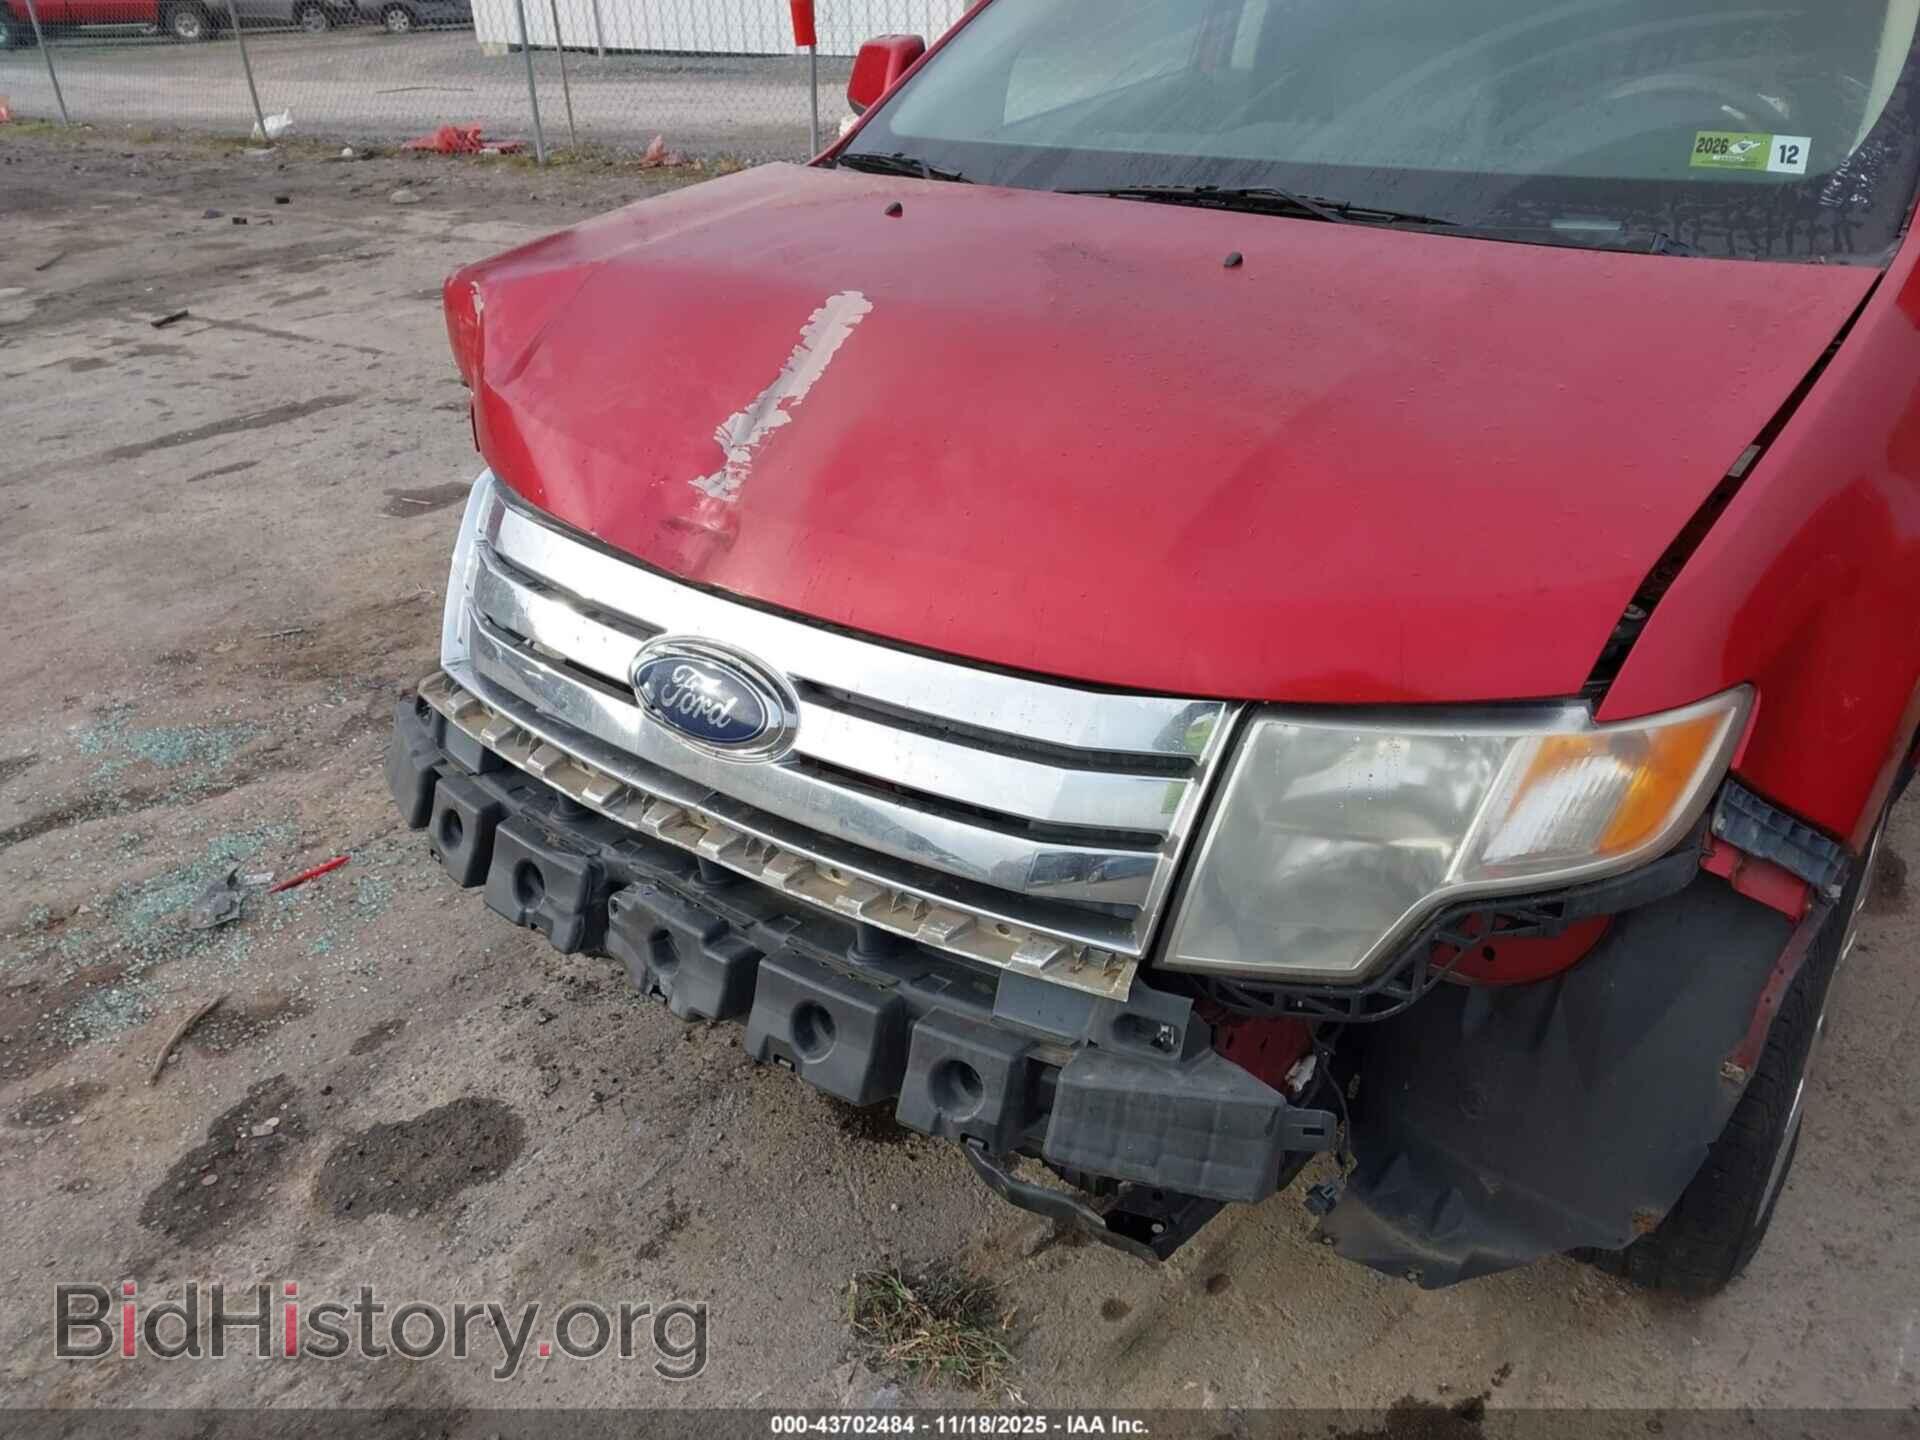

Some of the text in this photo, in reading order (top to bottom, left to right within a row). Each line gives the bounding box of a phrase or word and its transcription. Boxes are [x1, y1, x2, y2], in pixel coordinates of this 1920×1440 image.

[1695, 137, 1800, 165] 2026 12
[660, 664, 739, 729] Ford
